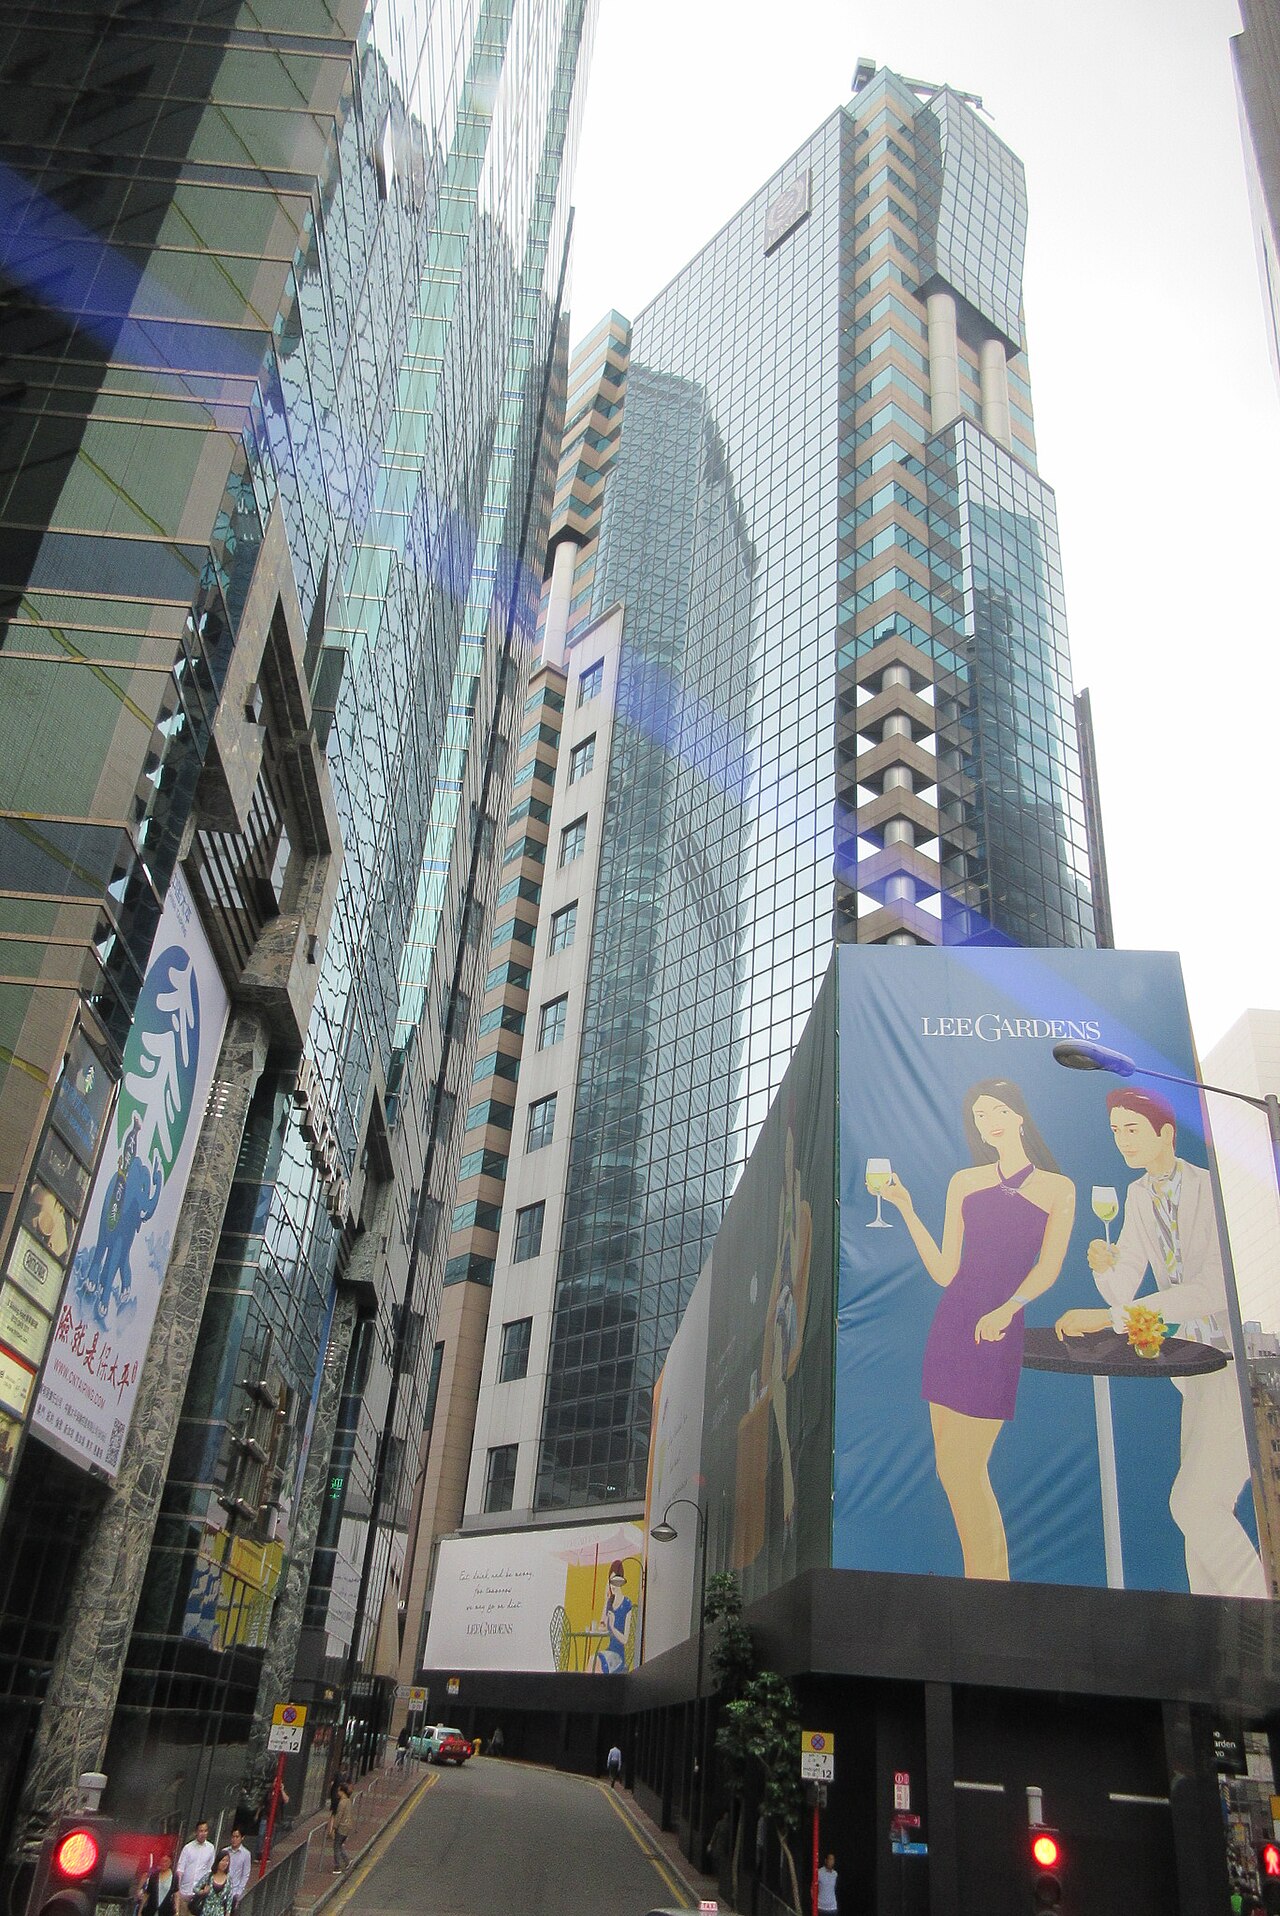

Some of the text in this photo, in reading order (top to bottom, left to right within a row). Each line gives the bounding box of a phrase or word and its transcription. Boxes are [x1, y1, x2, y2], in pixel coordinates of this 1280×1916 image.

[921, 1013, 1101, 1042] LEE GARDENS
[472, 1584, 483, 1599] for
[291, 1727, 297, 1736] 7
[289, 1741, 299, 1751] 12
[821, 1755, 828, 1764] 7
[822, 1769, 832, 1778] 12
